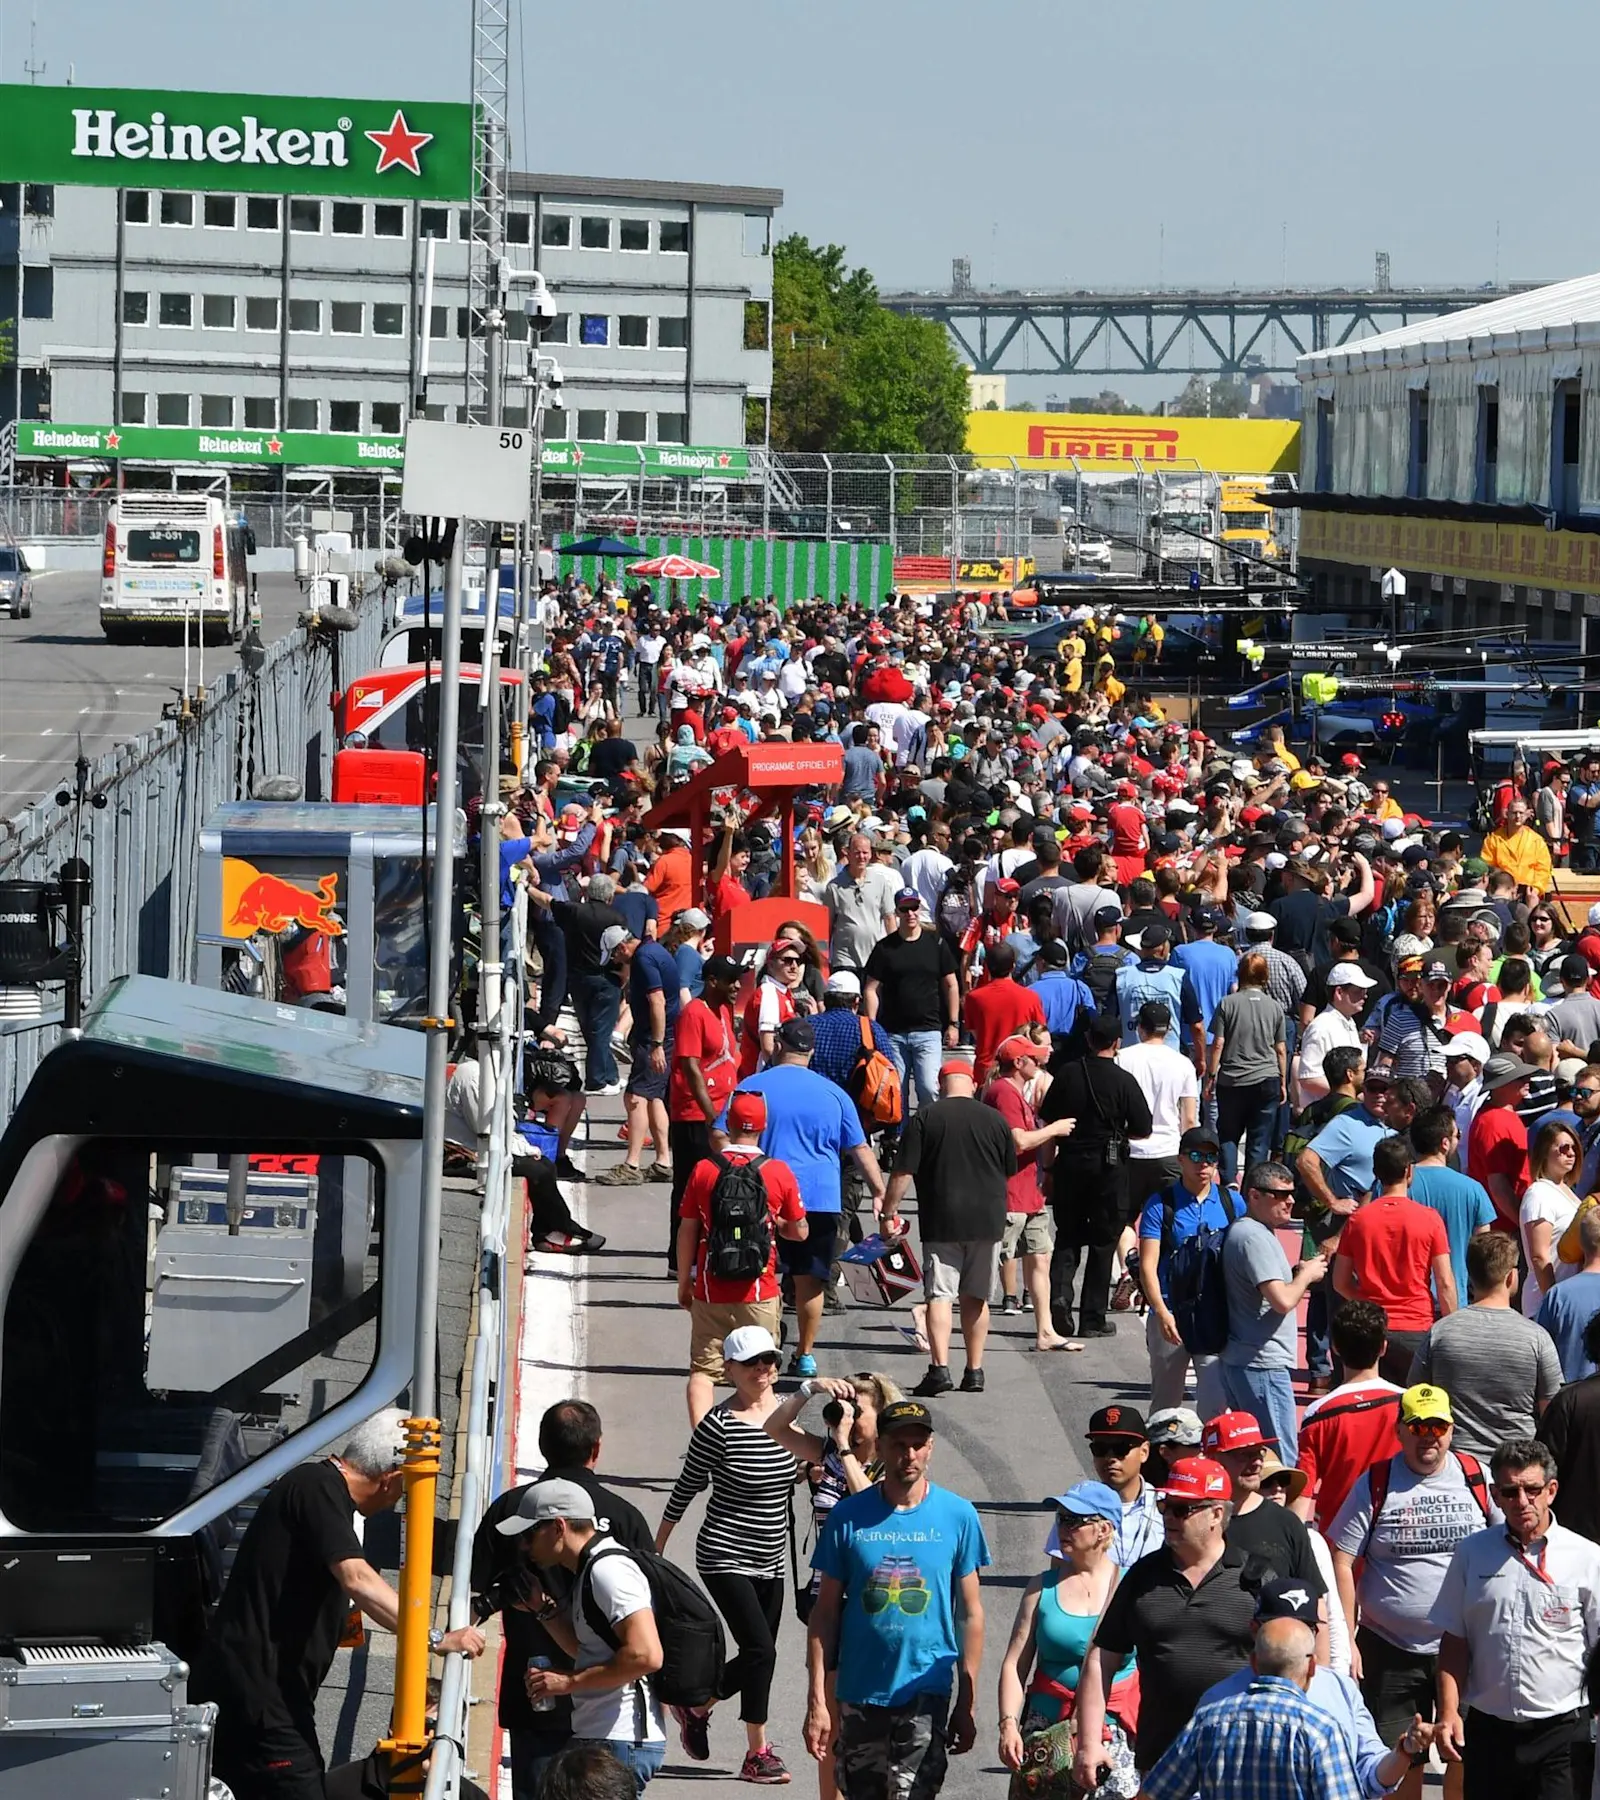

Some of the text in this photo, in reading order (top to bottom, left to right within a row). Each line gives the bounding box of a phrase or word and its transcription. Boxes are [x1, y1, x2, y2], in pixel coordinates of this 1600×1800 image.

[70, 108, 350, 168] Heineken
[33, 429, 98, 449] Heineken
[198, 434, 262, 455] Heineken
[499, 432, 523, 450] 50
[1028, 425, 1179, 462] PIRELLI
[1292, 651, 1358, 660] McLAREN HONDA
[752, 762, 795, 772] PROGRAMME
[796, 761, 826, 771] OFFICIEL
[1390, 1502, 1473, 1516] SPRINGSTEEN
[1412, 1495, 1450, 1506] BRUCE
